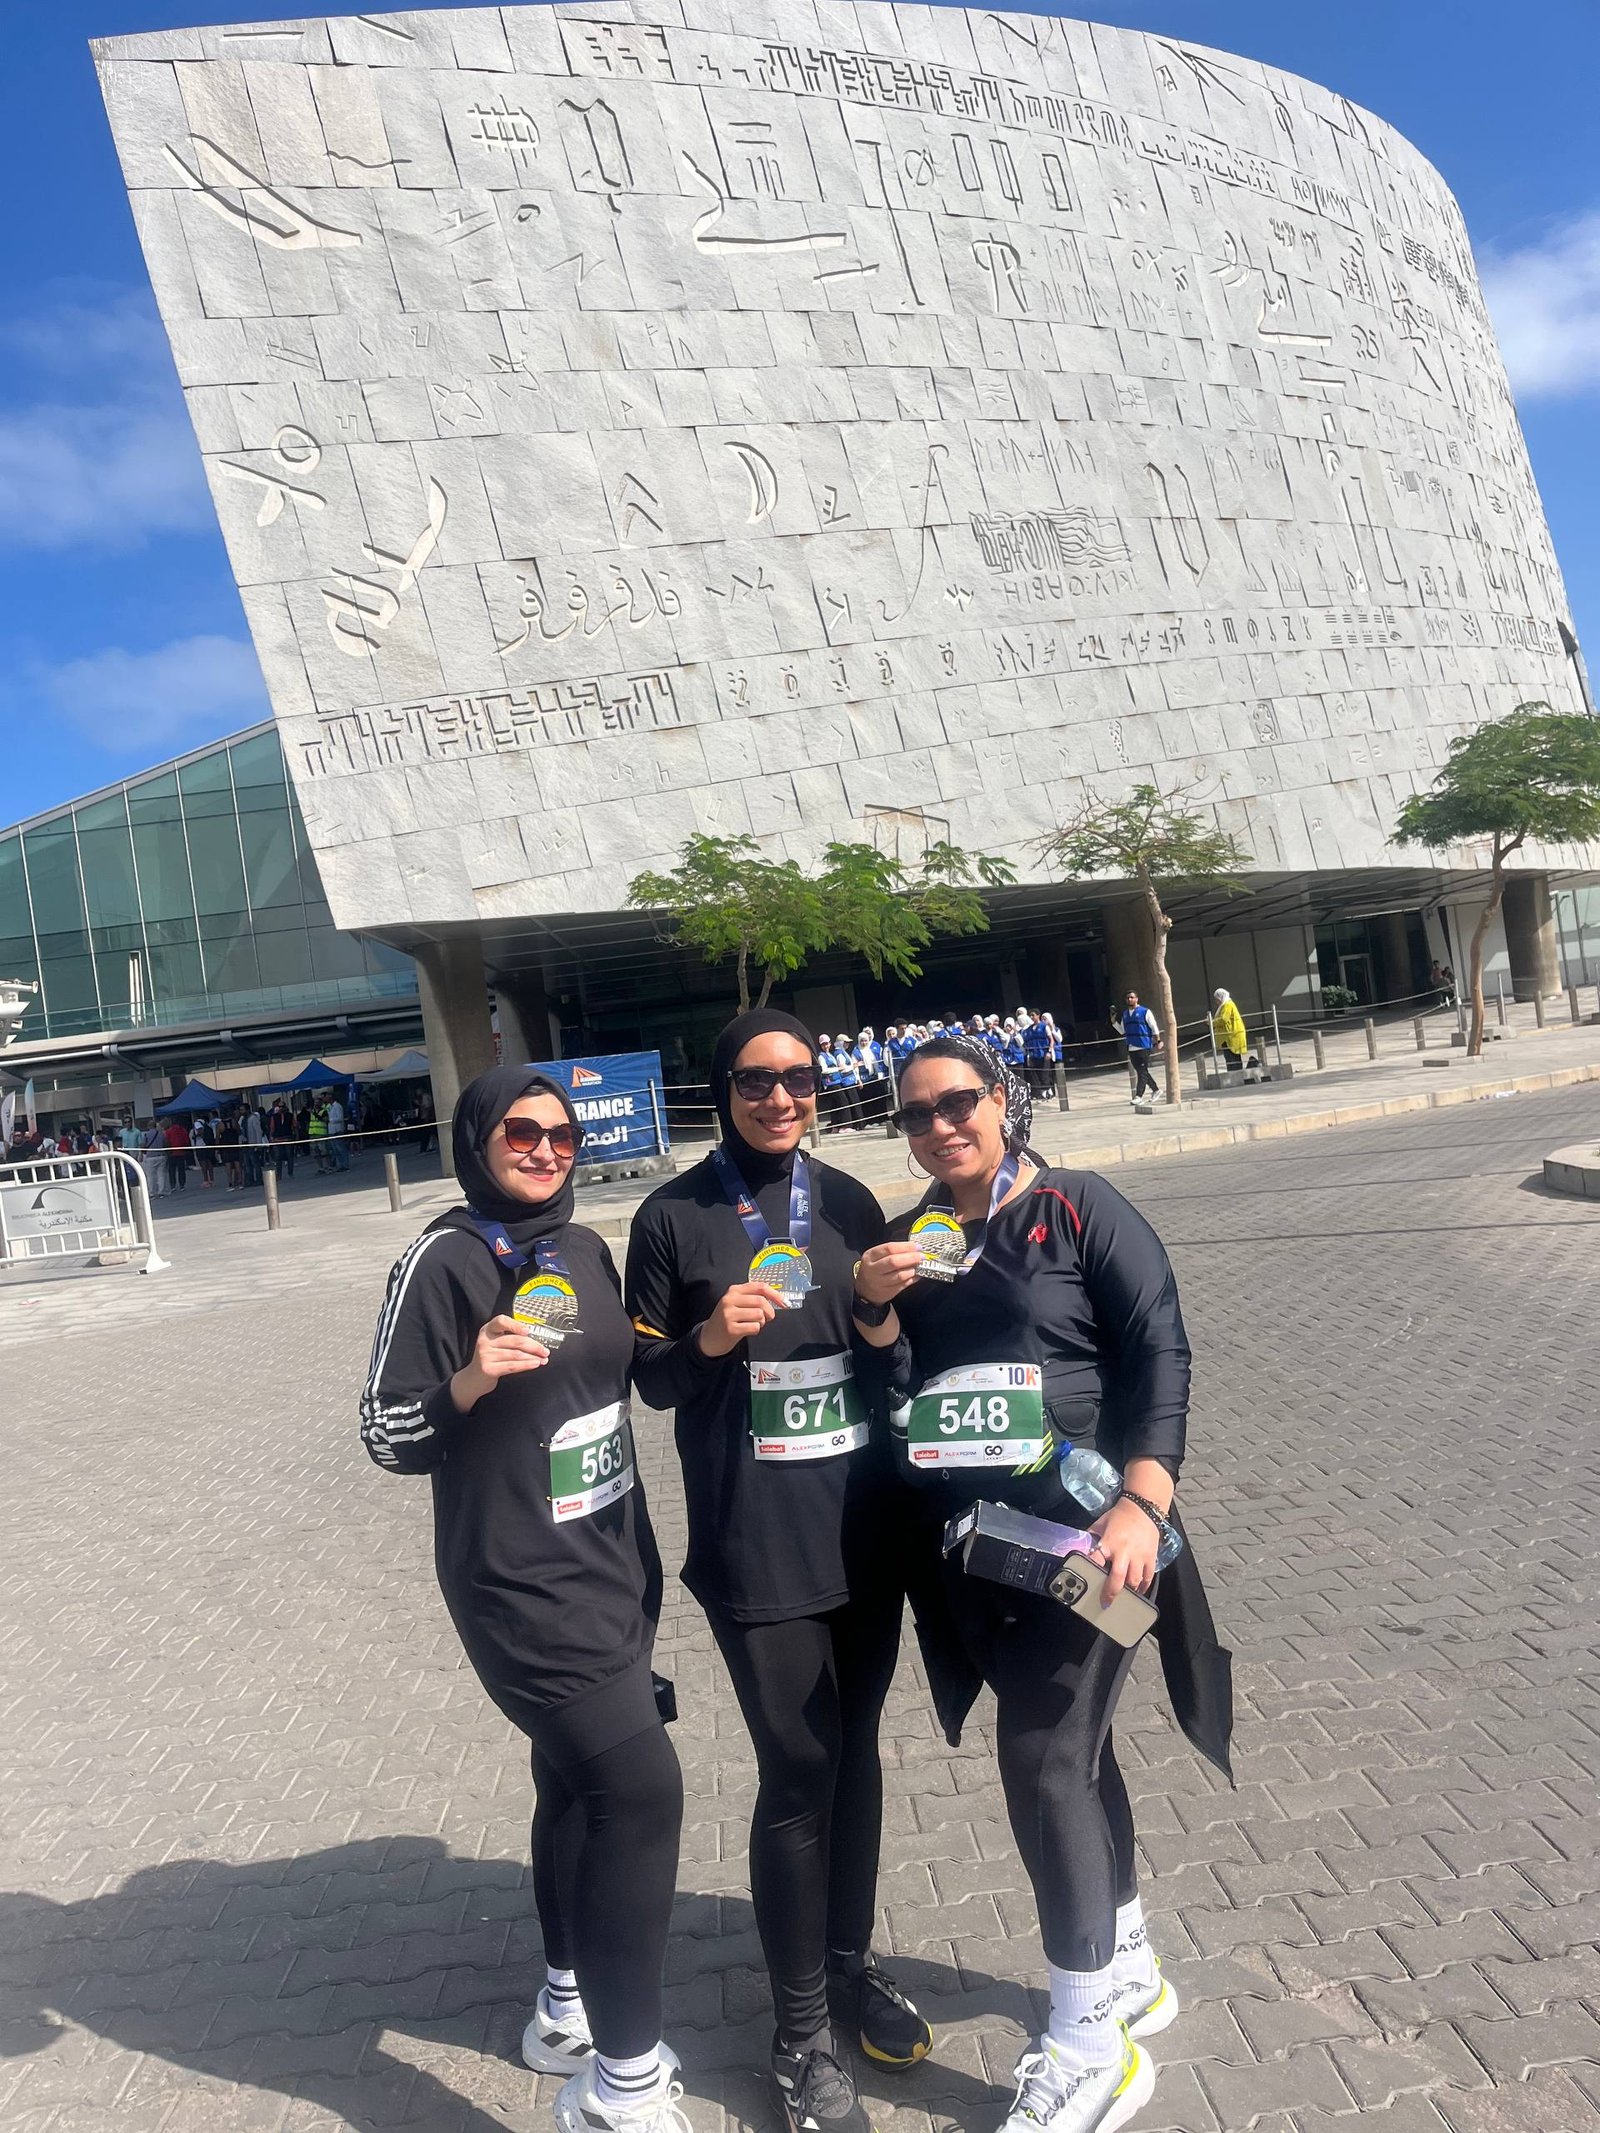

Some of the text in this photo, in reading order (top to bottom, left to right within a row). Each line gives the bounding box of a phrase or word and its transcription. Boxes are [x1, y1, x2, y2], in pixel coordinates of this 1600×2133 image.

[572, 1097, 635, 1121] RANCE
[920, 1215, 951, 1226] FINISHER
[529, 1277, 564, 1288] FINISHER
[1007, 1366, 1037, 1386] 10K
[783, 1387, 846, 1430] 671
[938, 1396, 1010, 1434] 548
[831, 1434, 846, 1446] GO
[581, 1434, 623, 1484] 563
[984, 1445, 1003, 1456] GO
